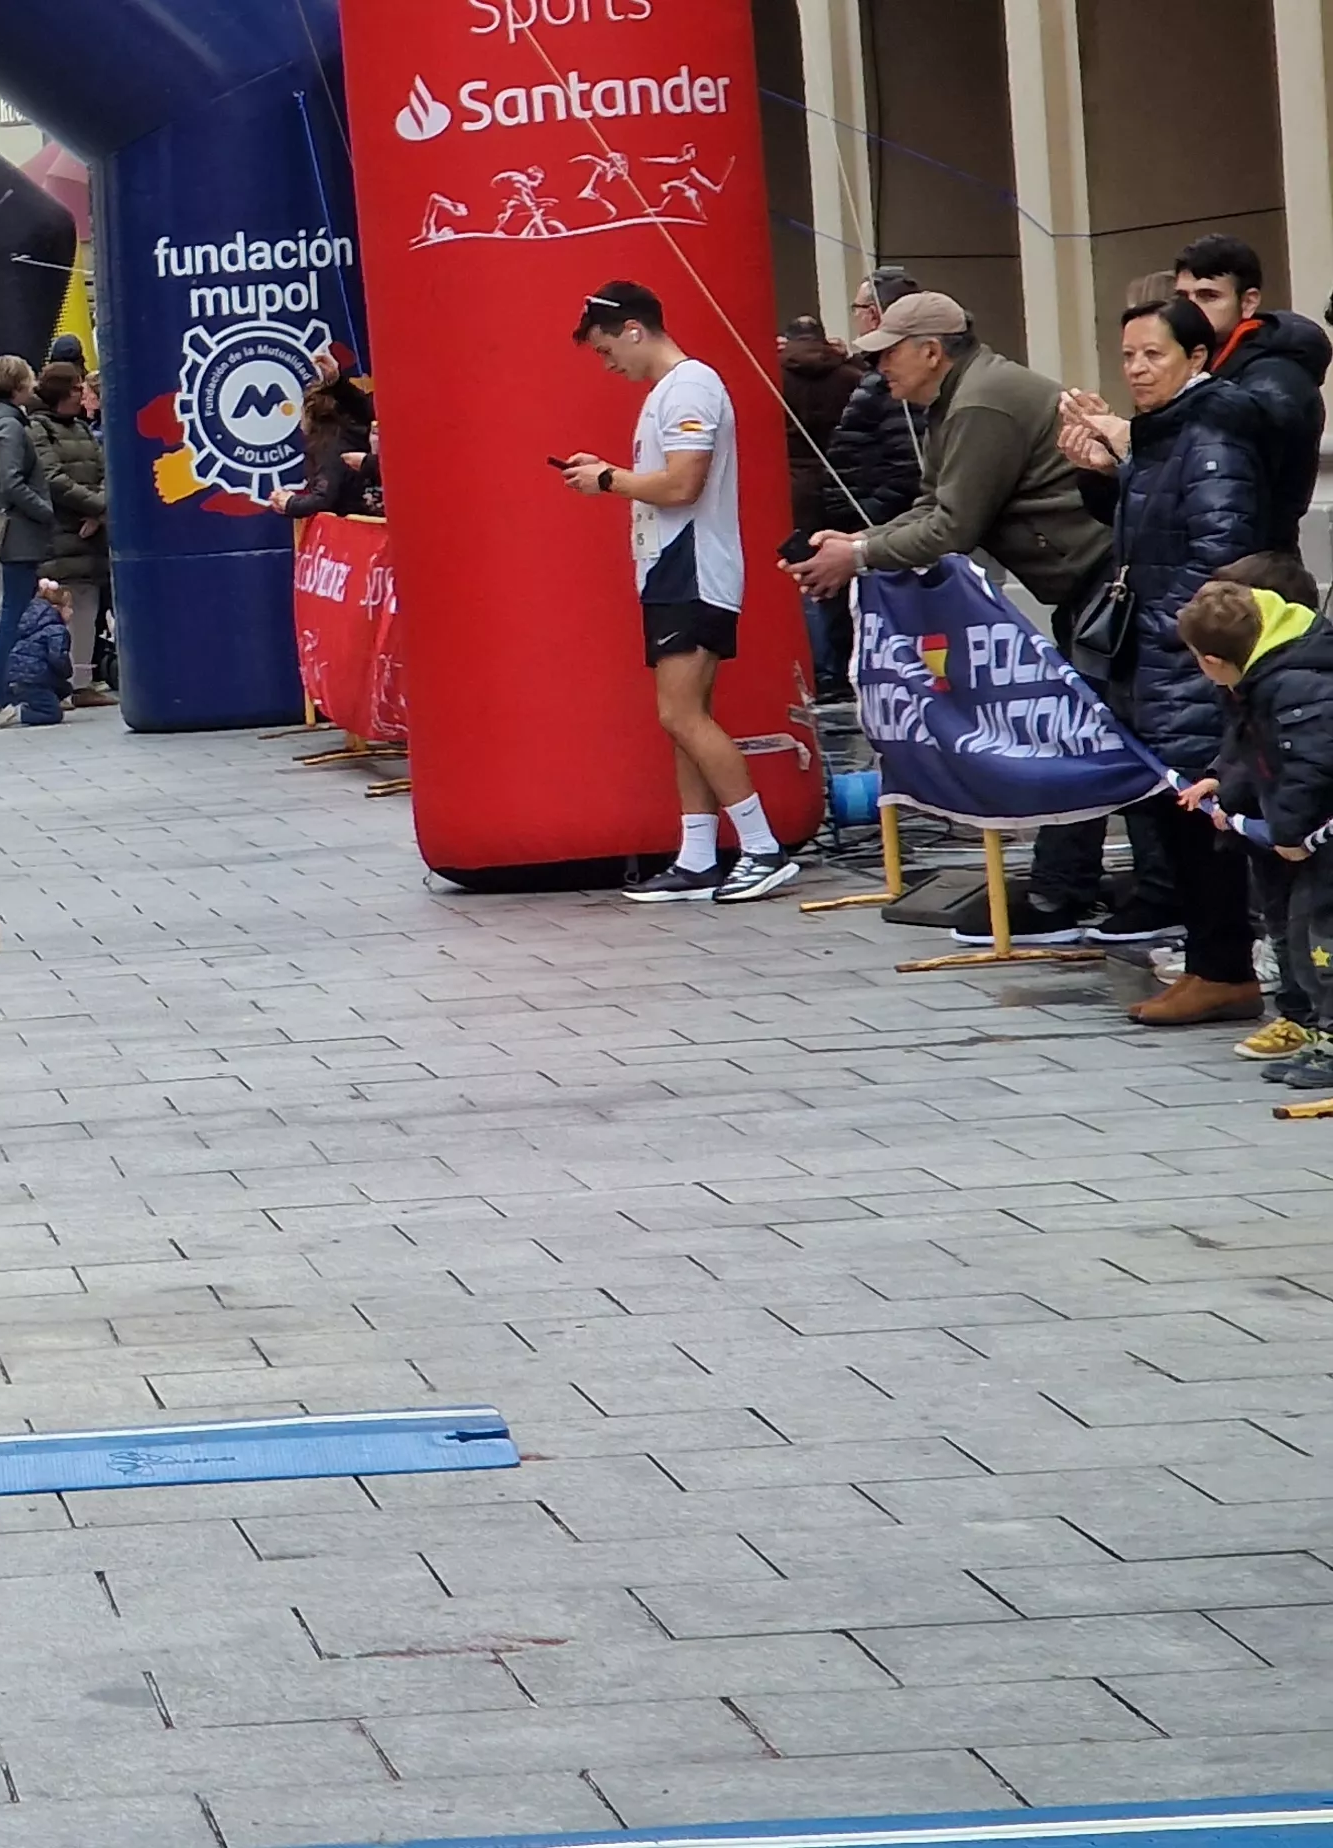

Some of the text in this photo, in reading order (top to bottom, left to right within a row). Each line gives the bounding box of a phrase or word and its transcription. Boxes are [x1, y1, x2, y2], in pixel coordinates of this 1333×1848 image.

[459, 65, 731, 132] Santander
[153, 226, 354, 278] fundación
[189, 271, 320, 322] mupol
[204, 344, 313, 418] Fundación de la Mutualidad
[232, 443, 296, 464] POLICÍA
